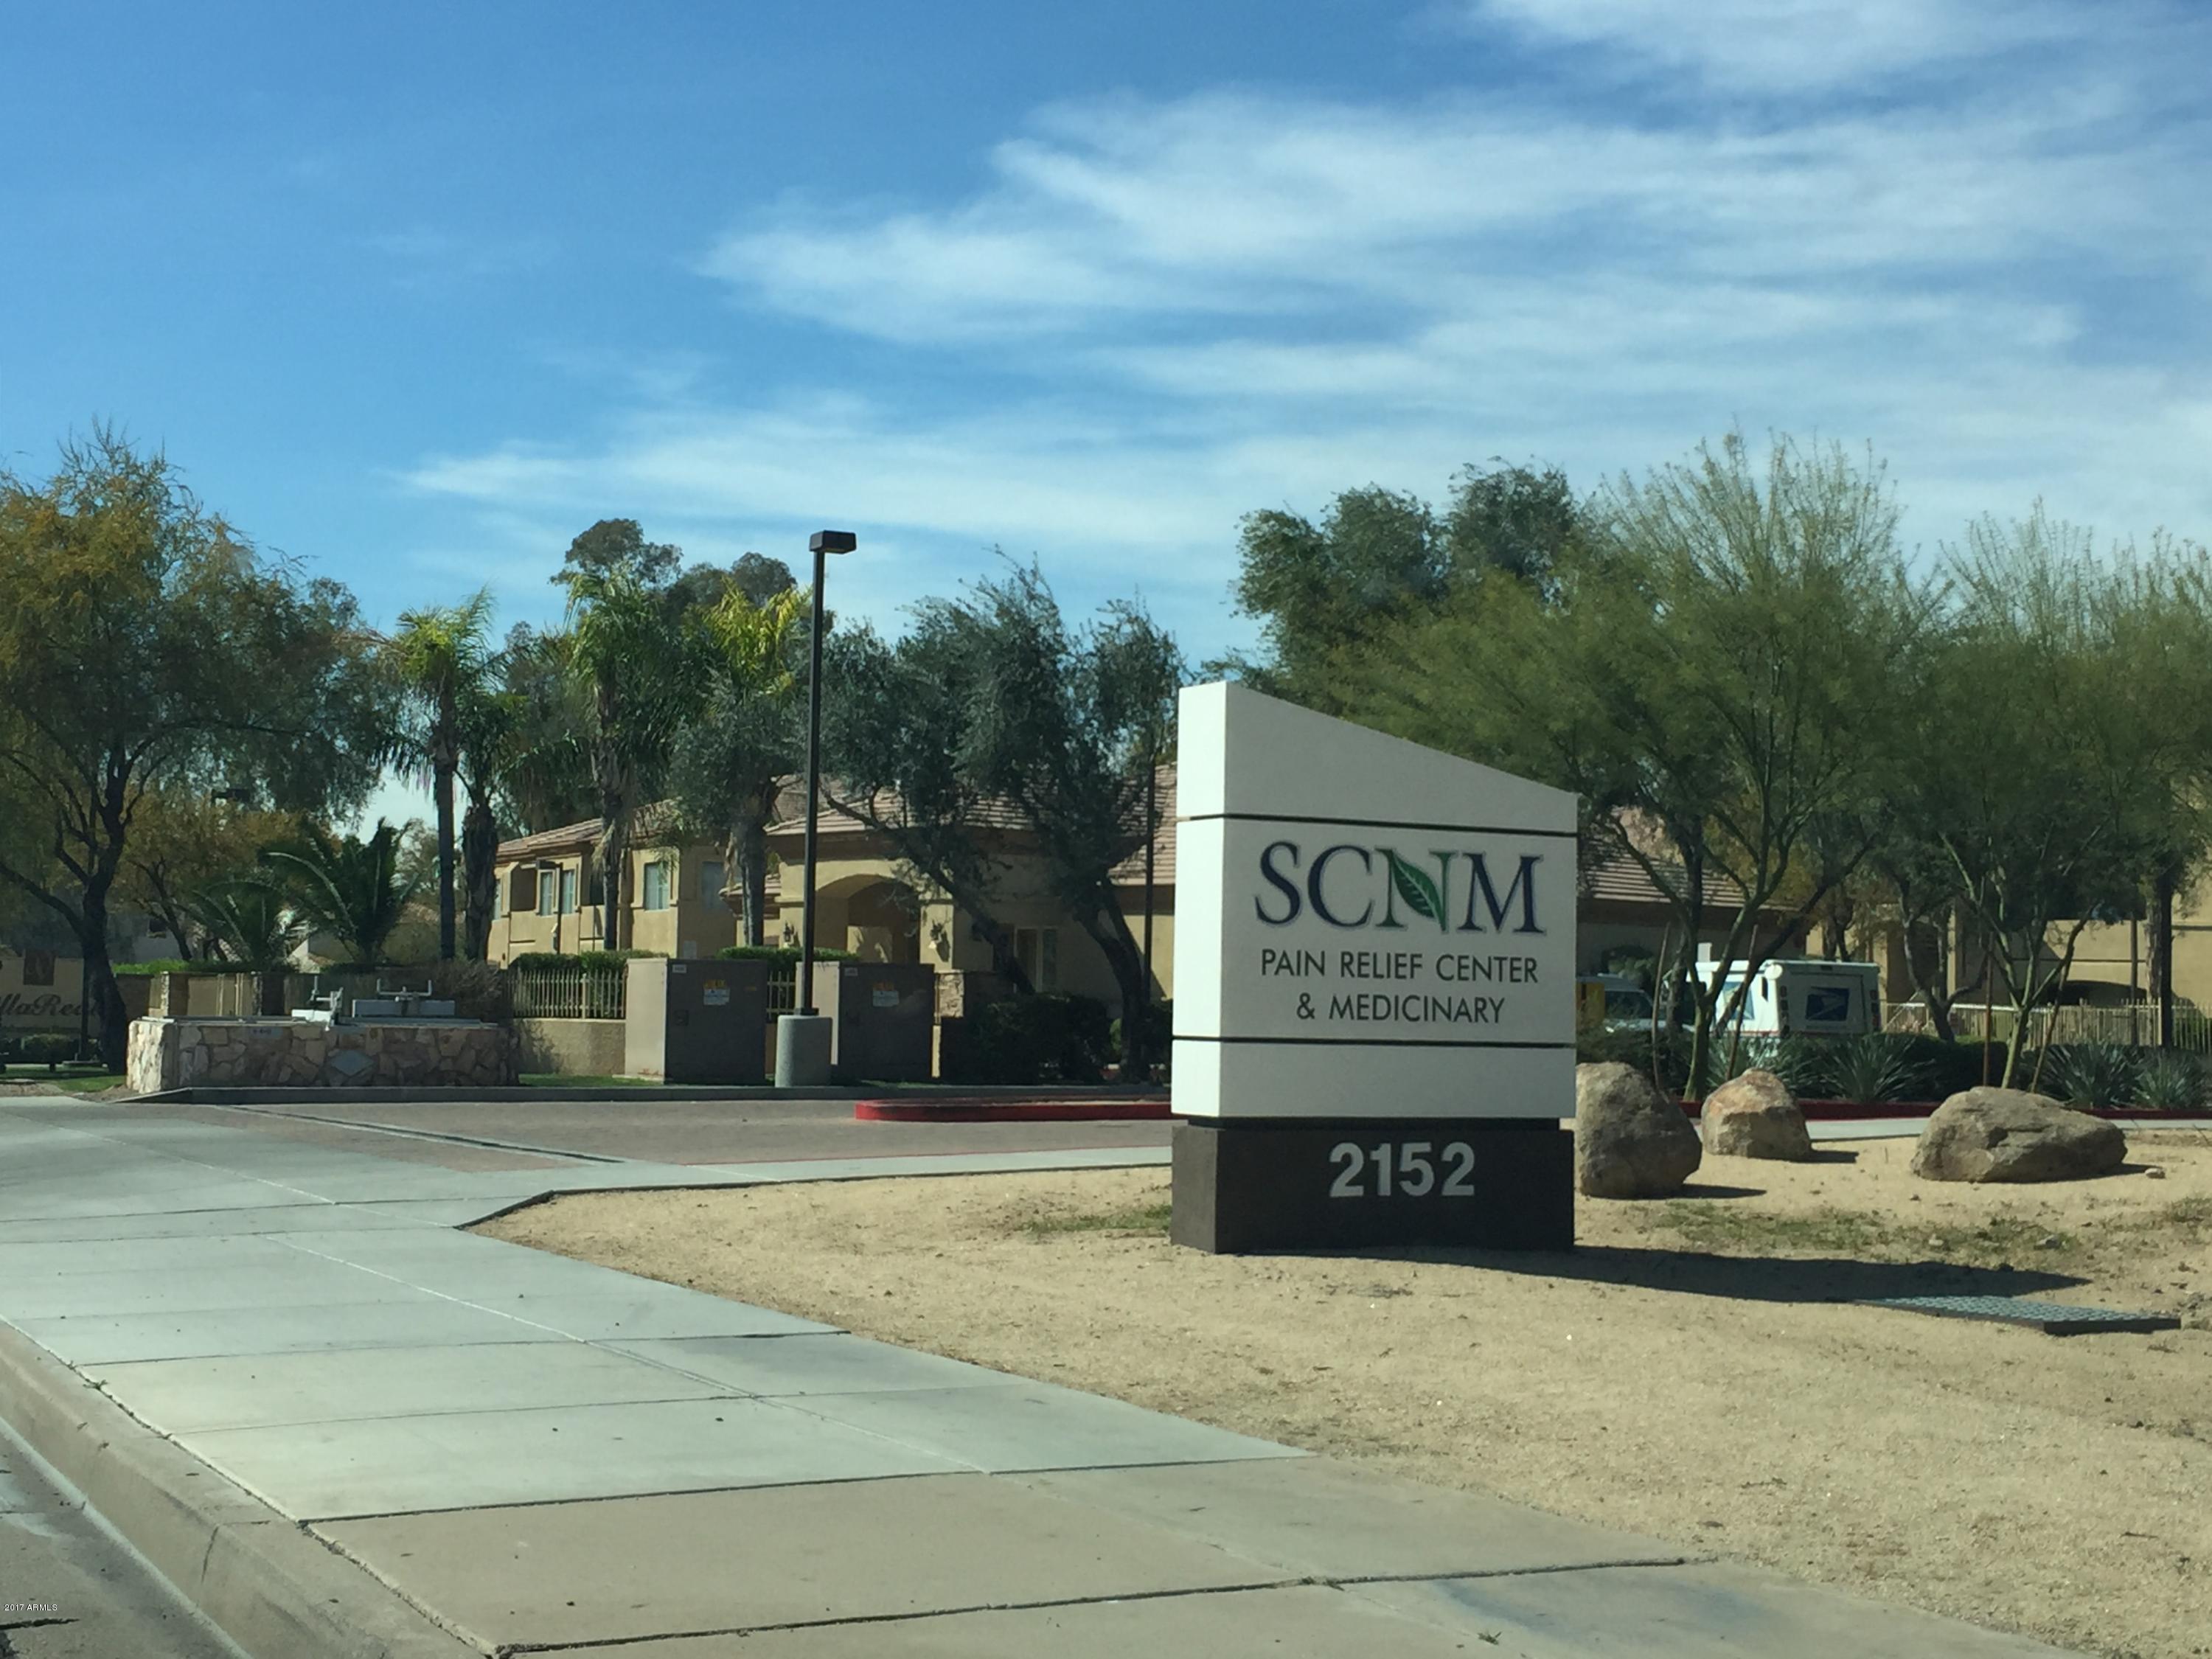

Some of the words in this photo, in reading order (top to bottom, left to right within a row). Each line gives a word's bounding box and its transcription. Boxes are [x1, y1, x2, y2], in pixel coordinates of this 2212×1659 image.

[1254, 840, 1546, 934] SCNM
[1262, 949, 1325, 975] PAIN
[1340, 951, 1422, 979] RELIEF
[1436, 954, 1538, 983] CENTER
[1296, 992, 1315, 1020] &
[1329, 994, 1506, 1023] MEDICINARY
[1329, 1142, 1475, 1197] 2152
